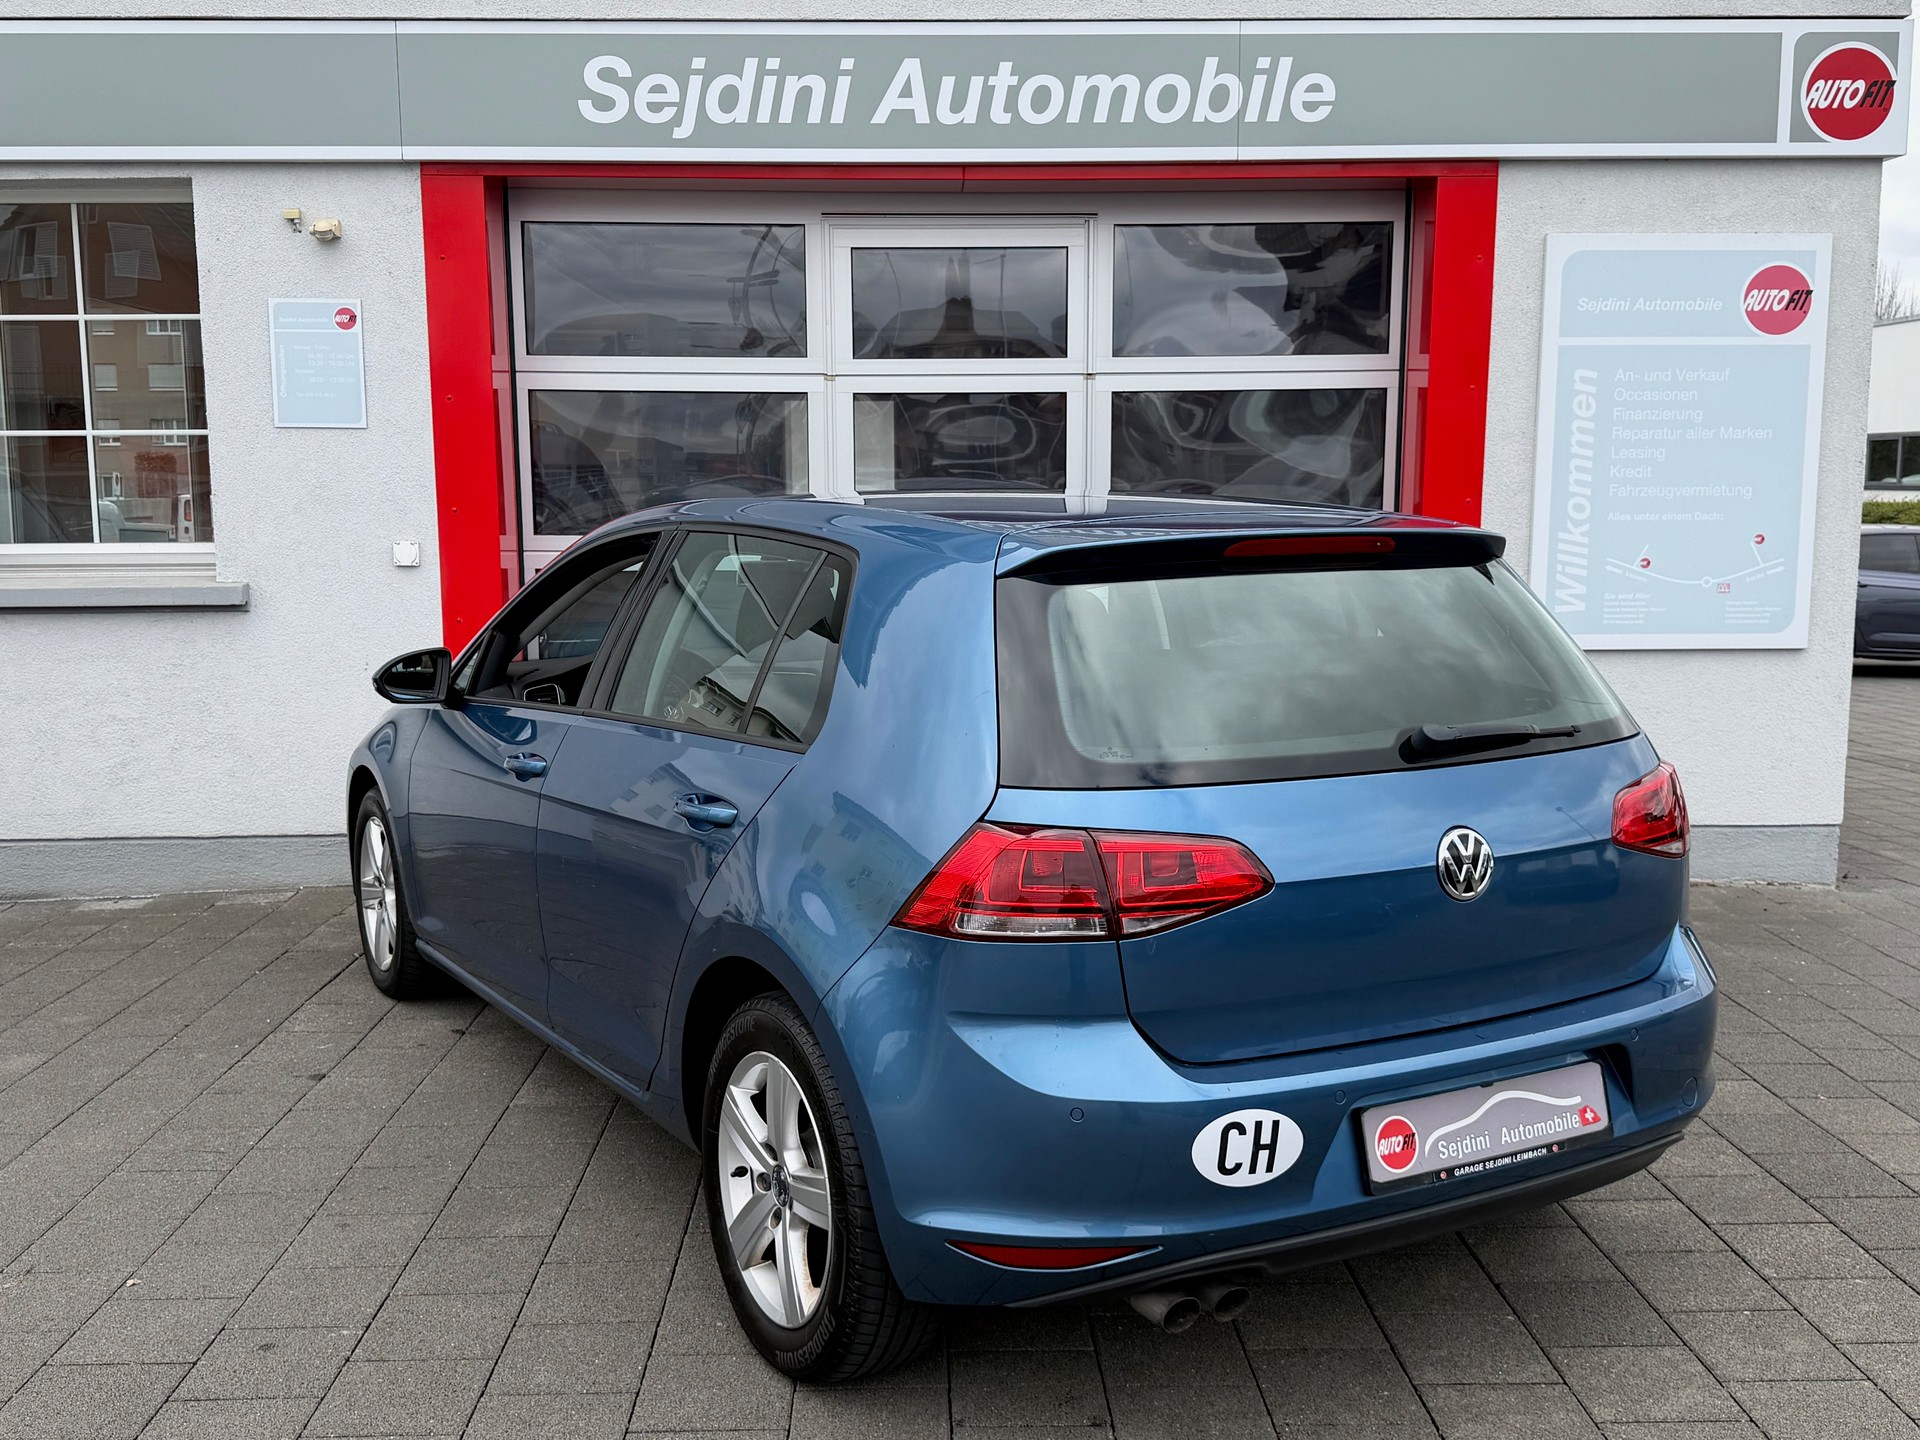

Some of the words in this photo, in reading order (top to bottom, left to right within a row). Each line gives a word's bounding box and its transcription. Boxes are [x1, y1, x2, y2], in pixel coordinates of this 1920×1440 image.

[578, 56, 853, 138] Sejdini
[871, 57, 1336, 124] Automobile
[1806, 79, 1897, 109] AUTOFIT
[1577, 297, 1631, 314] Sejdini
[1633, 297, 1722, 312] Automobile
[1744, 288, 1813, 312] AUTOFIT
[1614, 369, 1641, 382] An-
[1644, 369, 1672, 382] und
[1676, 368, 1730, 382] Verkauf
[1614, 388, 1698, 401] Occasionen
[1613, 407, 1703, 422] Finanzierung
[1612, 427, 1681, 442] Reparatur
[1685, 426, 1715, 440] aller
[1719, 426, 1773, 440] Marken
[1611, 446, 1666, 461] Leasing
[1610, 465, 1652, 479] Kredit
[1554, 368, 1598, 613] Willkommen
[1609, 484, 1752, 500] Fahrzeugvermietung
[1607, 512, 1631, 521] Alles
[1634, 512, 1659, 521] unter
[1662, 512, 1692, 521] einem
[1378, 1132, 1416, 1156] AUTOFIT
[1438, 1130, 1491, 1160] Sejdini
[1501, 1111, 1580, 1145] Automobile
[1217, 1119, 1281, 1177] CH
[1454, 1163, 1484, 1176] GARAGE
[1485, 1156, 1512, 1170] SEJDINI
[1513, 1147, 1547, 1164] LEIMBACH
